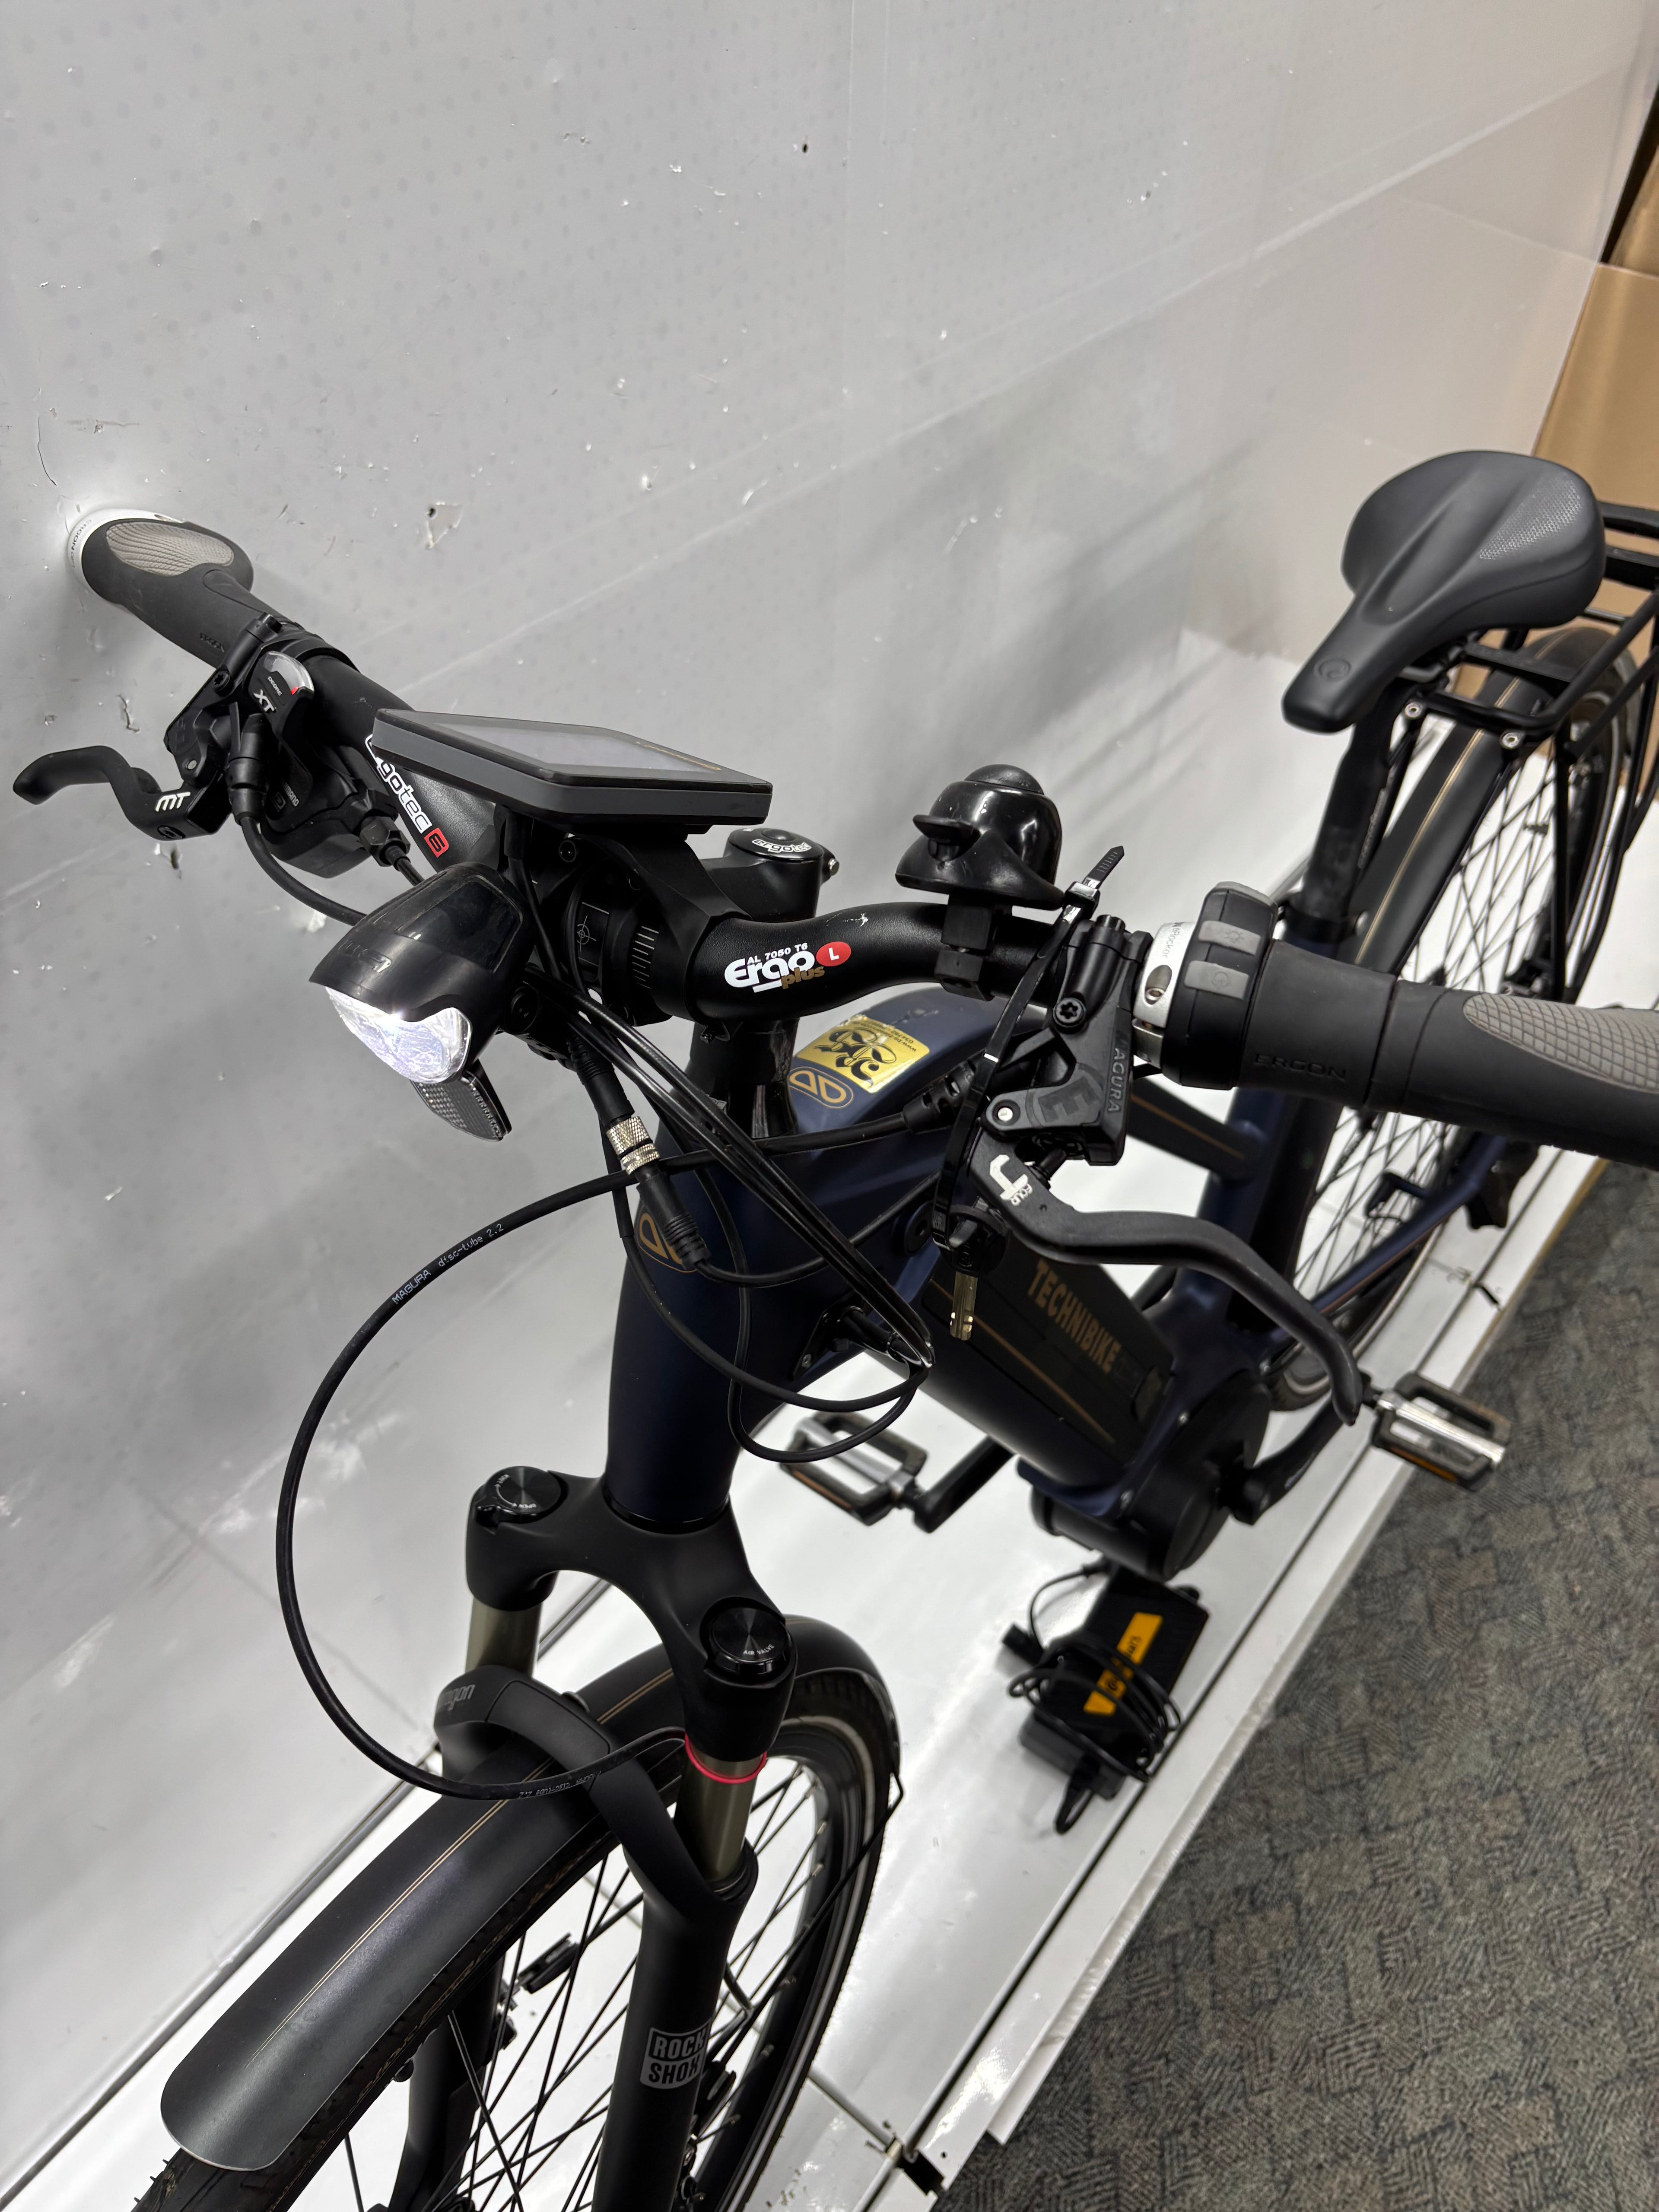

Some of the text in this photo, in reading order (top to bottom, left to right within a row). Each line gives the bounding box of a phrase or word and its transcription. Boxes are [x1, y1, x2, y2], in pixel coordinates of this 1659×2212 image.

[267, 676, 283, 696] DEORE
[253, 689, 276, 712] XT
[283, 782, 299, 807] IMANO
[365, 734, 432, 834] gotec
[155, 791, 191, 812] MT
[751, 839, 812, 853] ergotec
[747, 942, 808, 965] AL 7050 T6
[828, 947, 840, 961] L
[781, 966, 825, 989] plus
[1255, 1054, 1347, 1082] ERGON
[392, 1269, 431, 1304] MAGURA
[438, 1236, 483, 1267] disc-tube
[1027, 1258, 1122, 1374] TECHNIBIKE
[756, 1644, 775, 1655] VALVE
[653, 2026, 707, 2059] ROCK
[648, 2053, 701, 2084] SHOX
